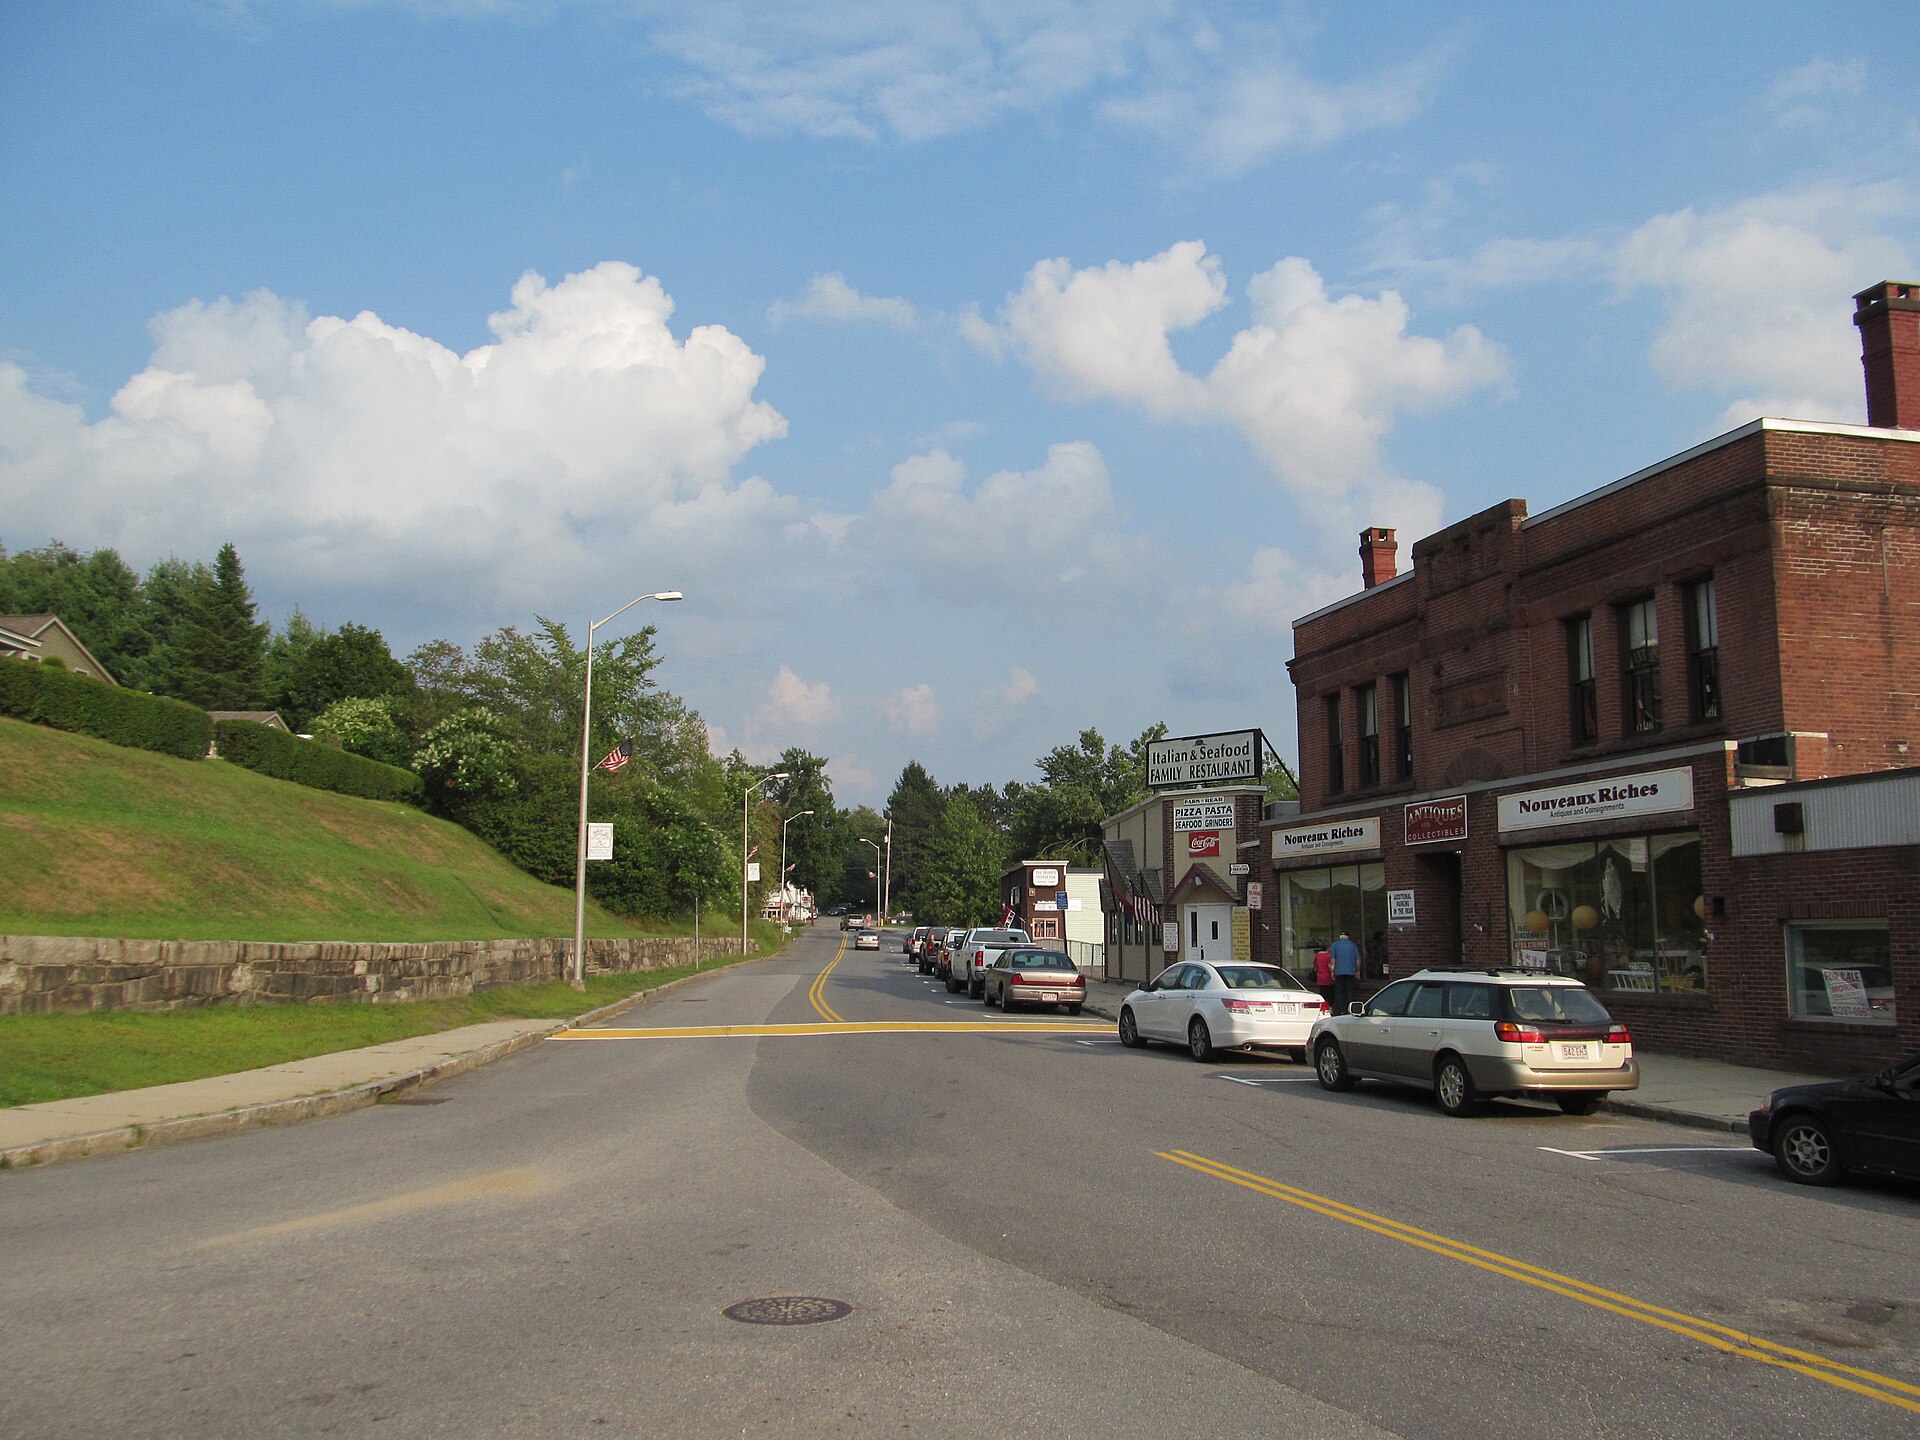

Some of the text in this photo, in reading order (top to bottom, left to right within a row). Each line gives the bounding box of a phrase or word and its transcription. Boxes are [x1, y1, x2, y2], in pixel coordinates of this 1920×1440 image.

[1153, 741, 1250, 765] Italian & Seafood
[1150, 759, 1251, 783] FAMILY RESTAURANT
[1519, 783, 1659, 814] Nouveaux Riches
[1175, 806, 1233, 817] PIZZA PASTA
[1408, 804, 1464, 826] ANTIQUES
[1549, 803, 1625, 819] Antiques and Consignments
[1175, 818, 1233, 829] SEAFOOD GRINDERS
[1284, 826, 1364, 845] Nouveaux Riches
[1408, 827, 1465, 841] COLLECTIBLES
[1513, 941, 1548, 949] WELCOME
[1824, 971, 1861, 982] FOR SALE
[1831, 982, 1859, 993] MORIN
